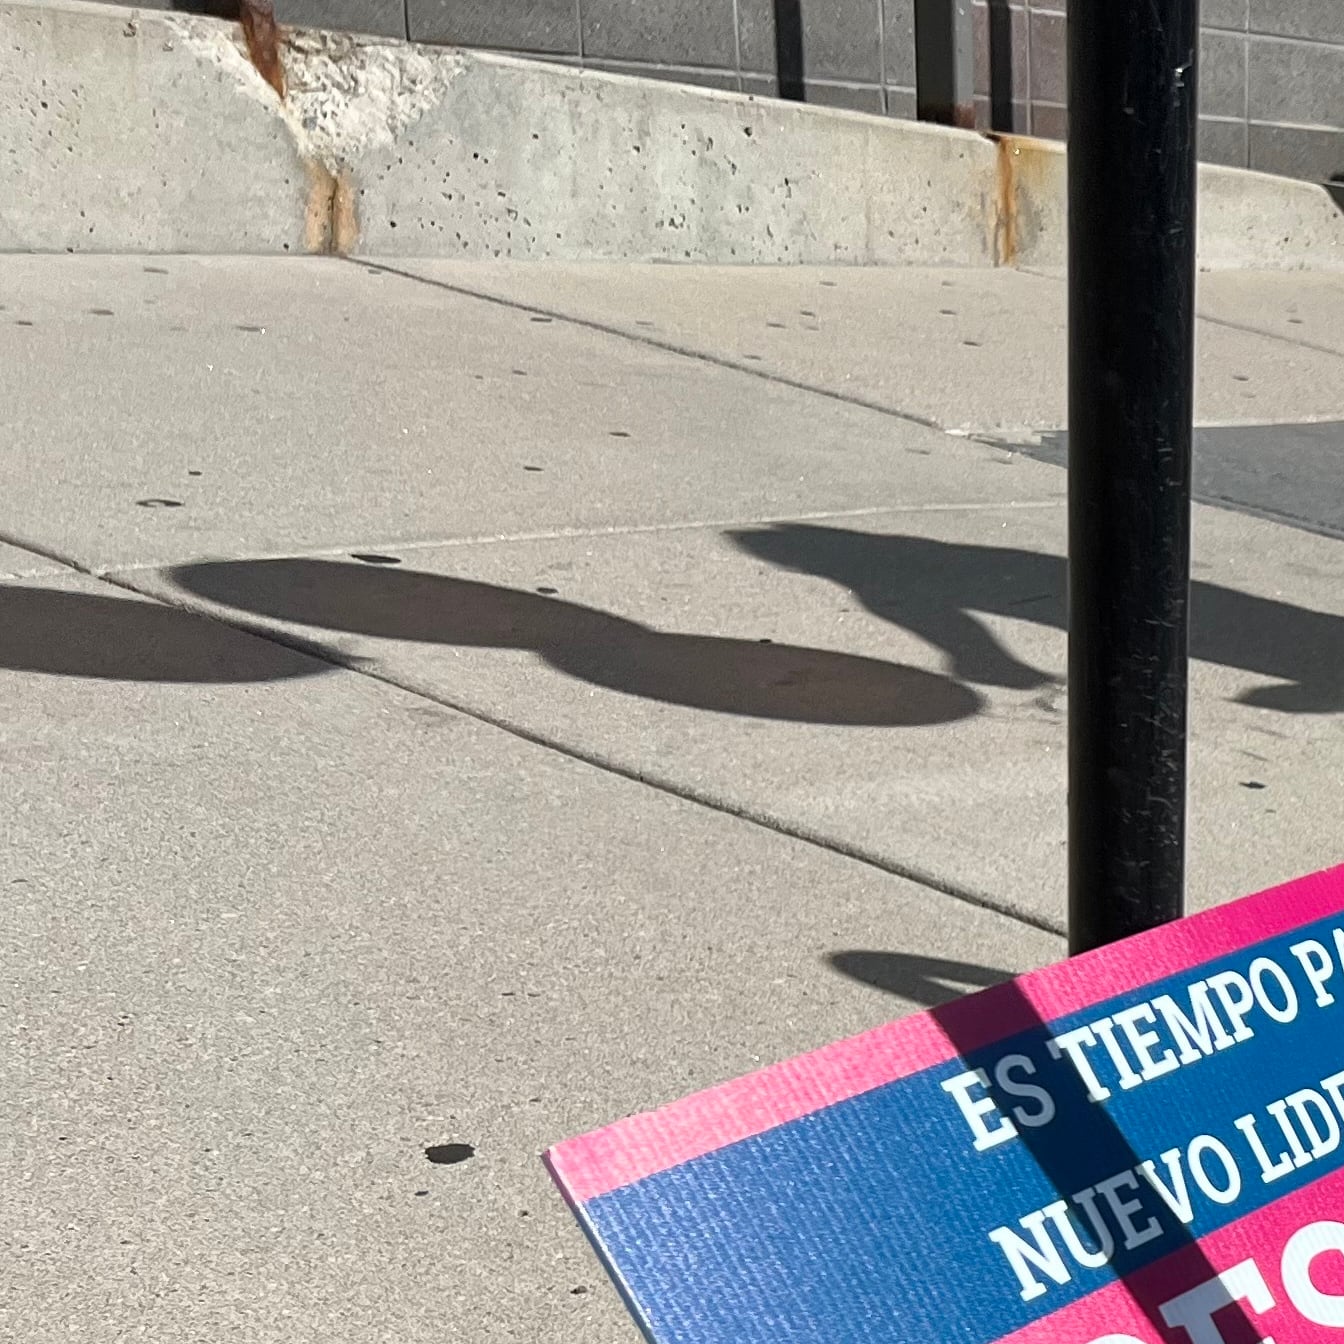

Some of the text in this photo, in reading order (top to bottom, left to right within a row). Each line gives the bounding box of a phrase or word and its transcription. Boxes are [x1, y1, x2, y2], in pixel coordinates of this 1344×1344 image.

[941, 1053, 1057, 1152] ES
[1050, 957, 1299, 1104] TIEMPO
[988, 1133, 1243, 1302] NUEVO
